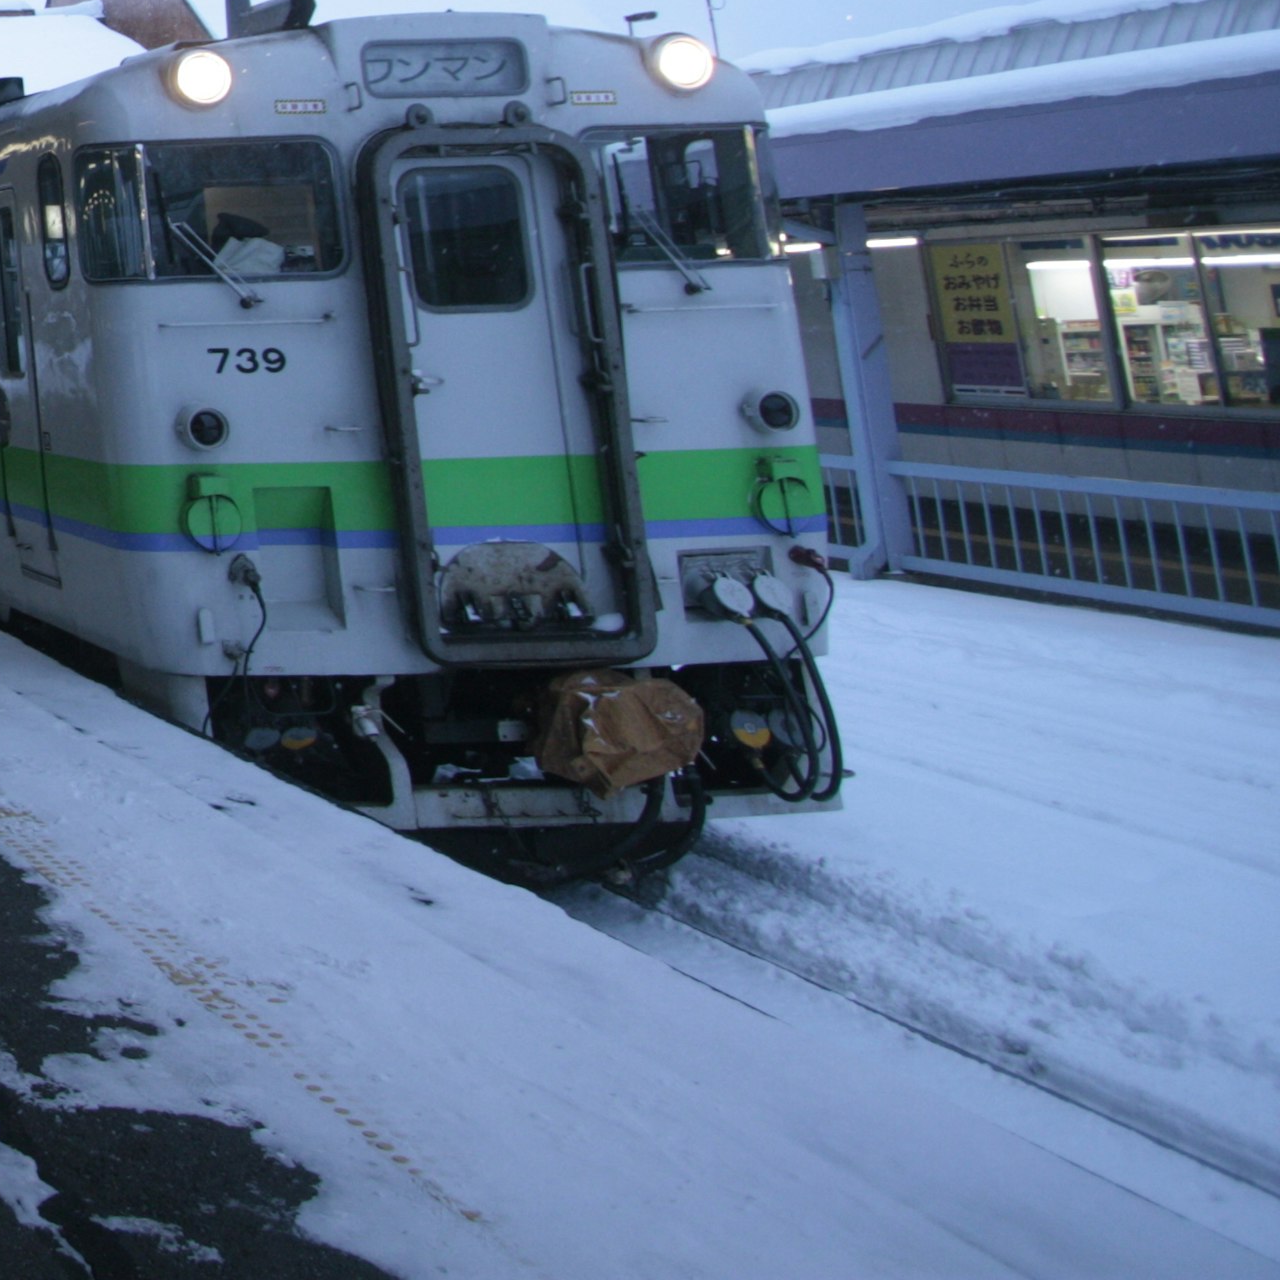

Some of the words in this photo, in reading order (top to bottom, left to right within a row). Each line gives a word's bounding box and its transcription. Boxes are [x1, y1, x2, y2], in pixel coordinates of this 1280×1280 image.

[943, 274, 1000, 290] おみやげ
[953, 296, 999, 312] お弁当
[206, 347, 286, 375] 739
